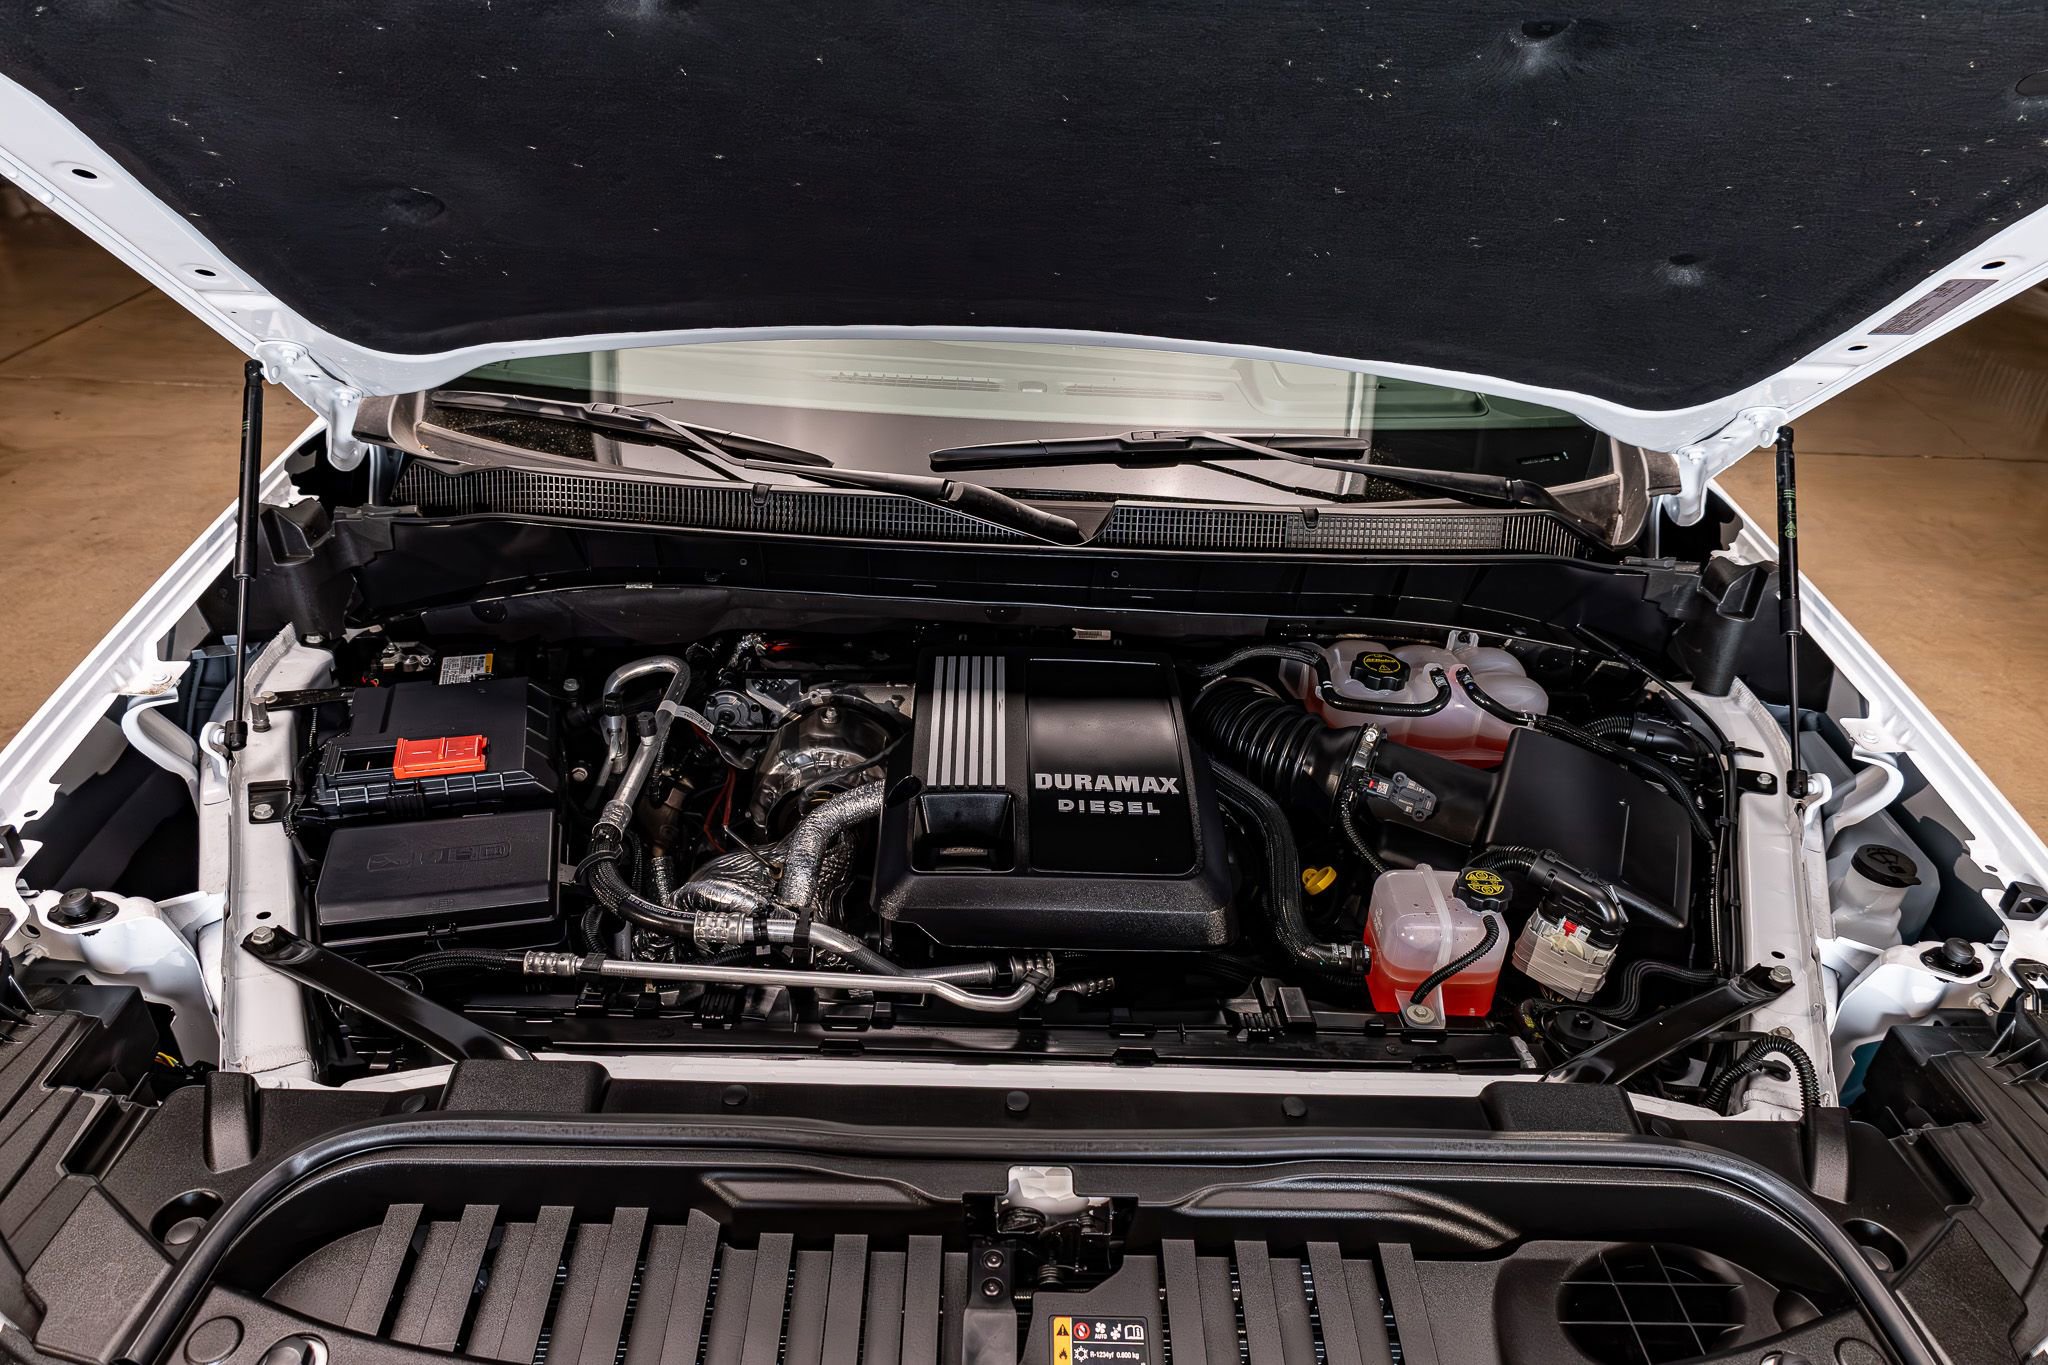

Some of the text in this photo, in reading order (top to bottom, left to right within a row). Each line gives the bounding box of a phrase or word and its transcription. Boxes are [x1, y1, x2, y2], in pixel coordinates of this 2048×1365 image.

[1034, 773, 1180, 794] DURAMAX
[1058, 799, 1161, 815] DIESEL
[1132, 1351, 1140, 1360] kg
